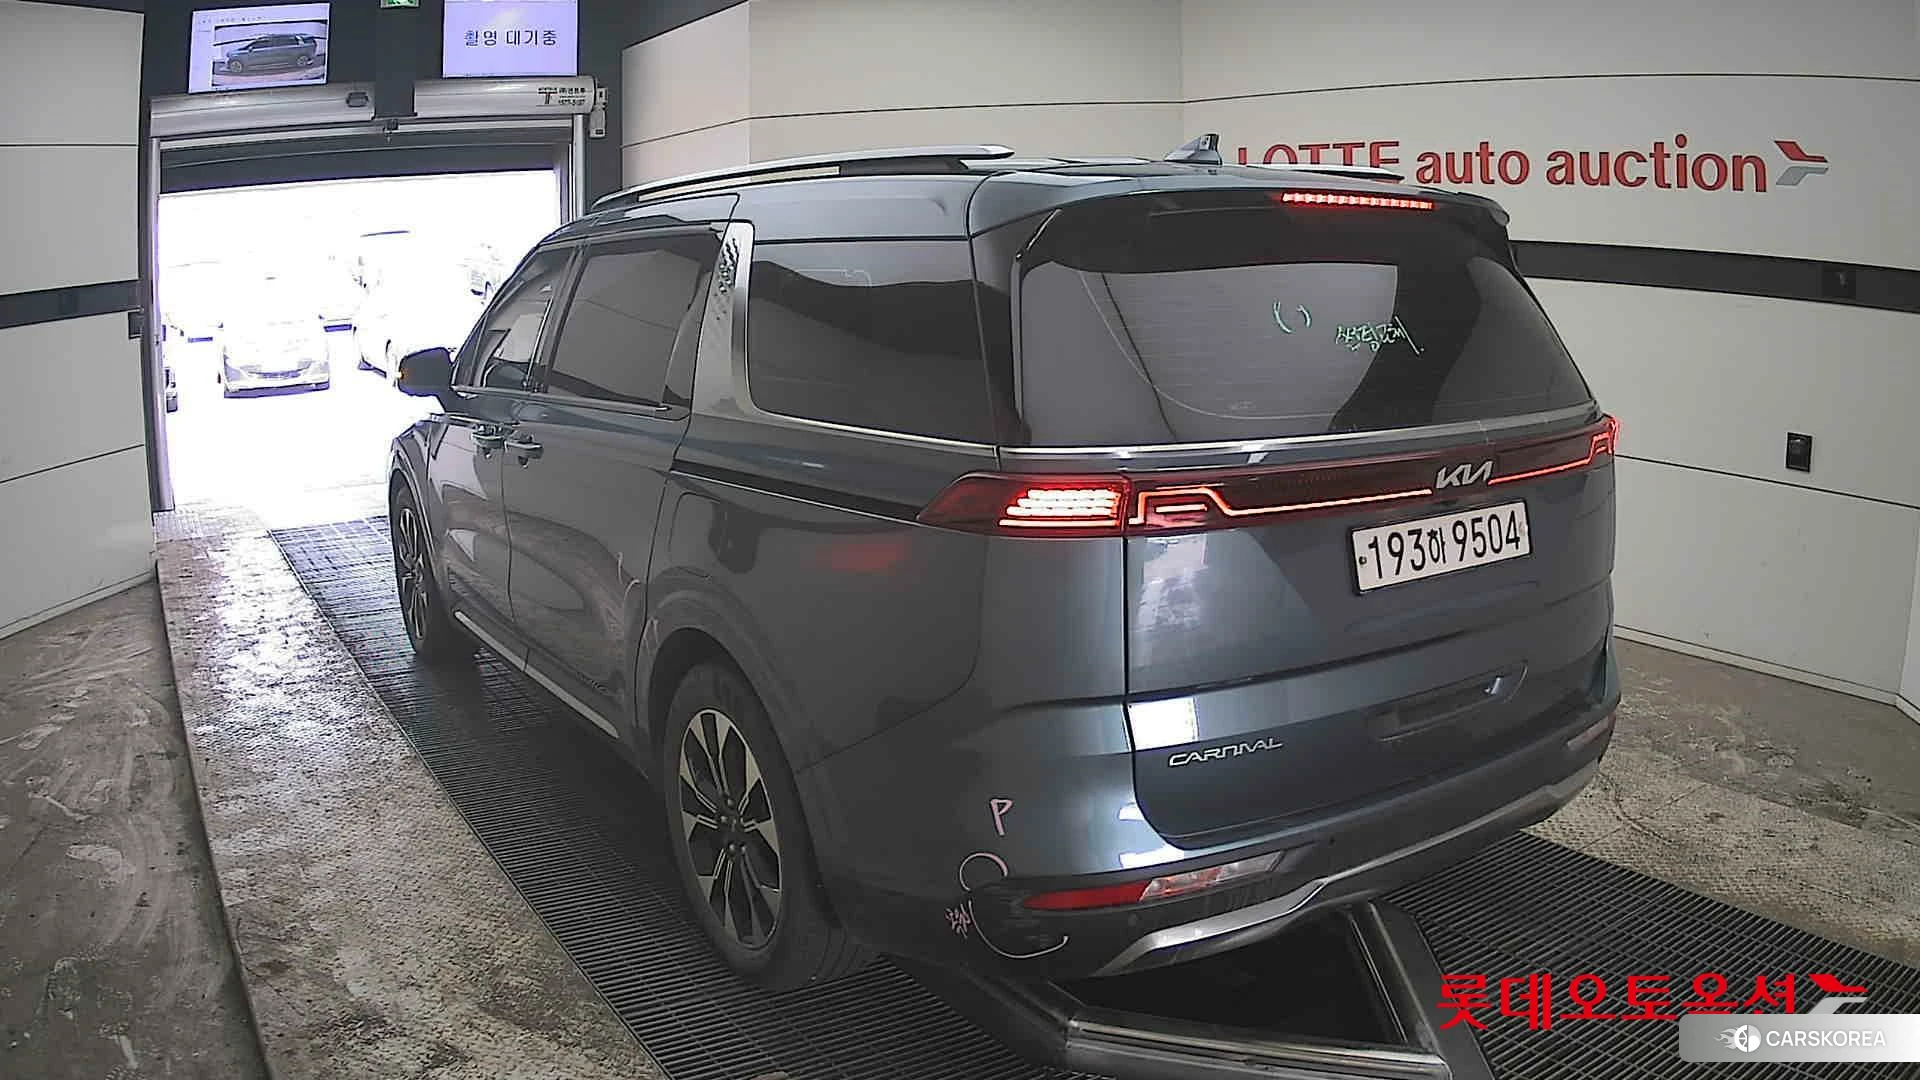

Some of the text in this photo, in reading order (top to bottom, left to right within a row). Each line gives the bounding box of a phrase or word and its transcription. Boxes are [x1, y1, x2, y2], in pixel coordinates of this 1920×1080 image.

[1415, 141, 1530, 185] auto
[1546, 134, 1767, 193] auction
[1169, 738, 1283, 767] CARNIVAL
[990, 799, 1013, 836] P
